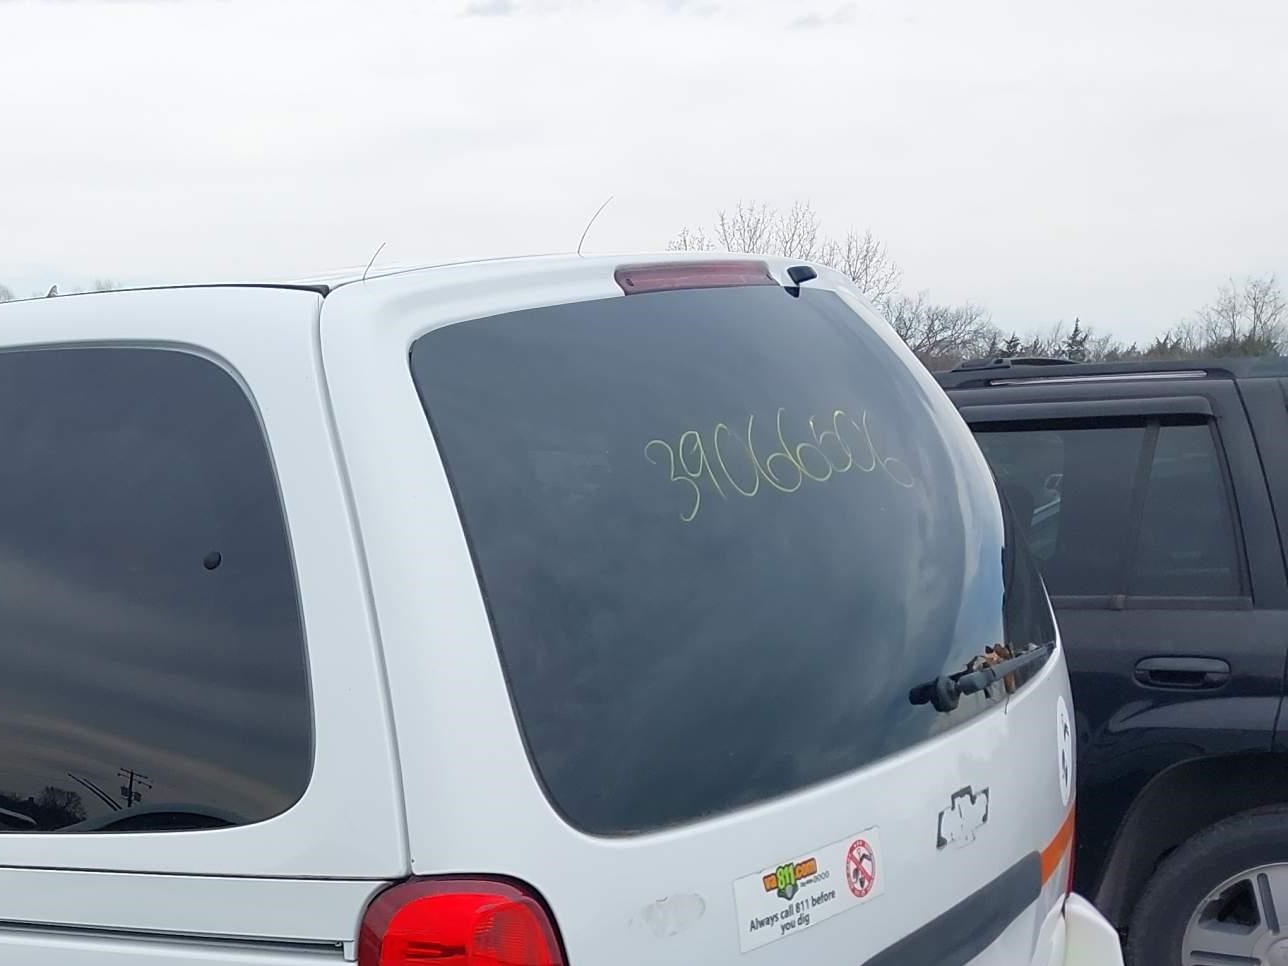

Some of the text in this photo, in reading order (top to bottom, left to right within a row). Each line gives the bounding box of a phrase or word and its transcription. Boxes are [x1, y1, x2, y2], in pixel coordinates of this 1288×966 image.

[750, 889, 836, 932] Always call 811 before
[780, 912, 811, 935] you dig
